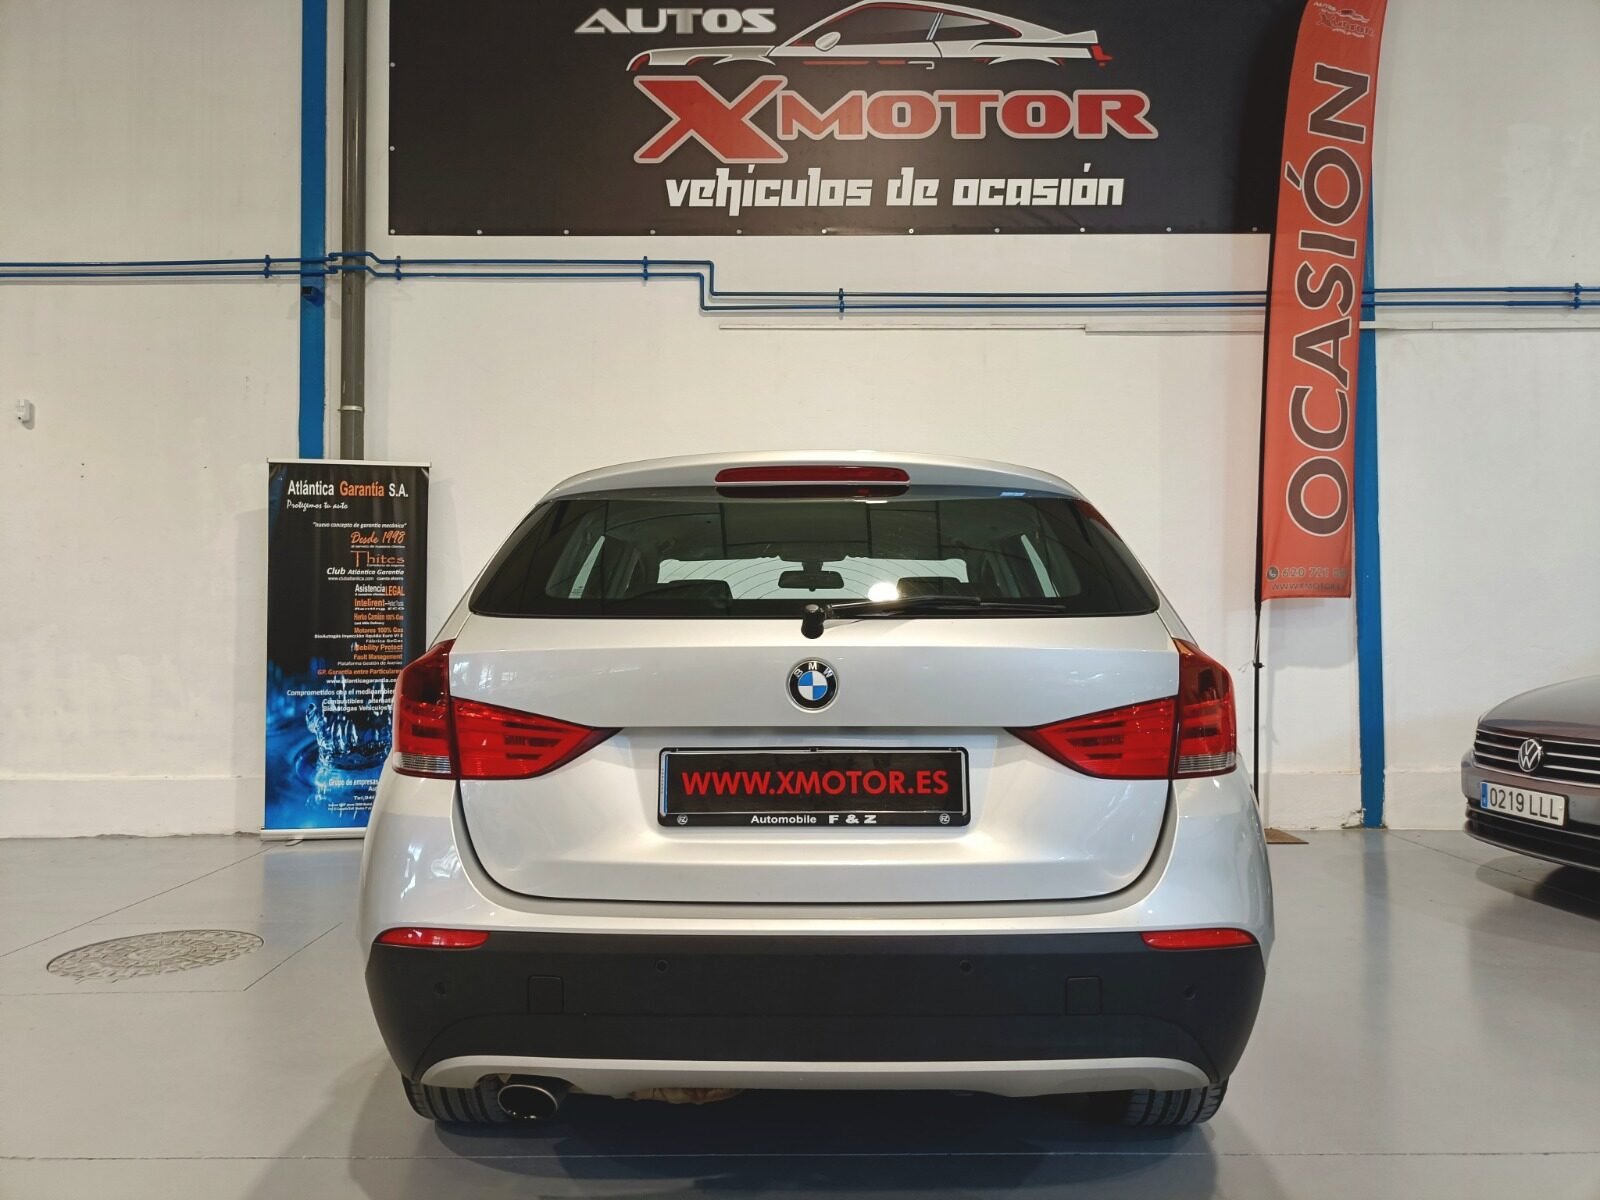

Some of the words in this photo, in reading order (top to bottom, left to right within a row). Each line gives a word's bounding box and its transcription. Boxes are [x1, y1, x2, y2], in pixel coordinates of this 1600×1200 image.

[574, 7, 776, 34] AUTOS
[633, 74, 1160, 164] XMOTOR
[886, 166, 939, 206] de
[952, 163, 1125, 206] ocasión
[1284, 62, 1371, 538] OCASIÓN
[287, 479, 335, 496] Atlántica
[339, 480, 385, 497] Garantía
[388, 482, 409, 498] S.A.
[323, 501, 331, 509] tu
[350, 531, 379, 544] Desde
[382, 530, 406, 544] 1998
[326, 567, 346, 575] Club
[794, 661, 835, 679] BMW
[681, 770, 949, 796] WWW.XMOTOR.ES
[1490, 787, 1525, 812] 0219
[1529, 794, 1559, 820] LLL
[750, 814, 817, 824] Automobile
[828, 815, 839, 824] F
[845, 814, 859, 824] &
[864, 815, 877, 824] Z
